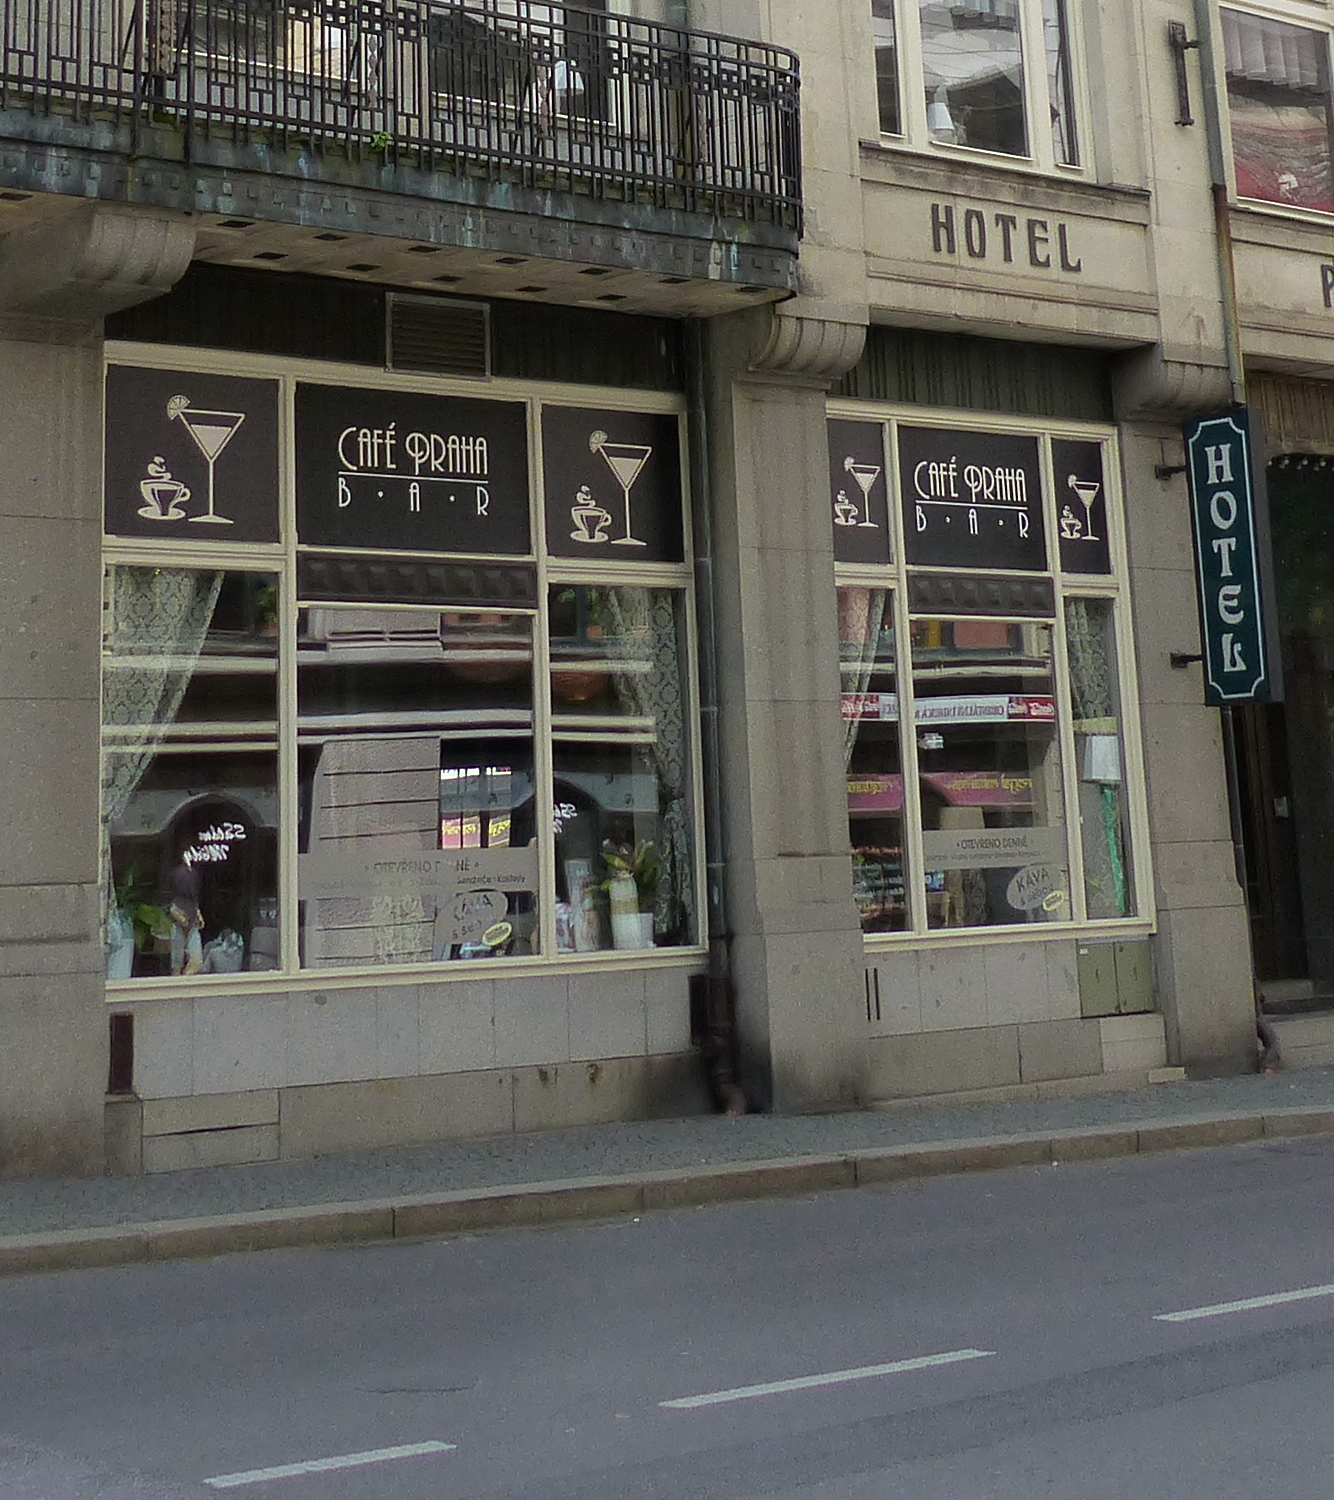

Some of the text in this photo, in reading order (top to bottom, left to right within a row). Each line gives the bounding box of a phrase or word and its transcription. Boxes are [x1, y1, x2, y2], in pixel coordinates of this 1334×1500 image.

[931, 203, 1082, 272] HOTEL
[338, 421, 490, 476] CAFÉ PRAHA
[914, 455, 1027, 503] CAFÉ PRAHA
[1204, 443, 1248, 673] HOTEL
